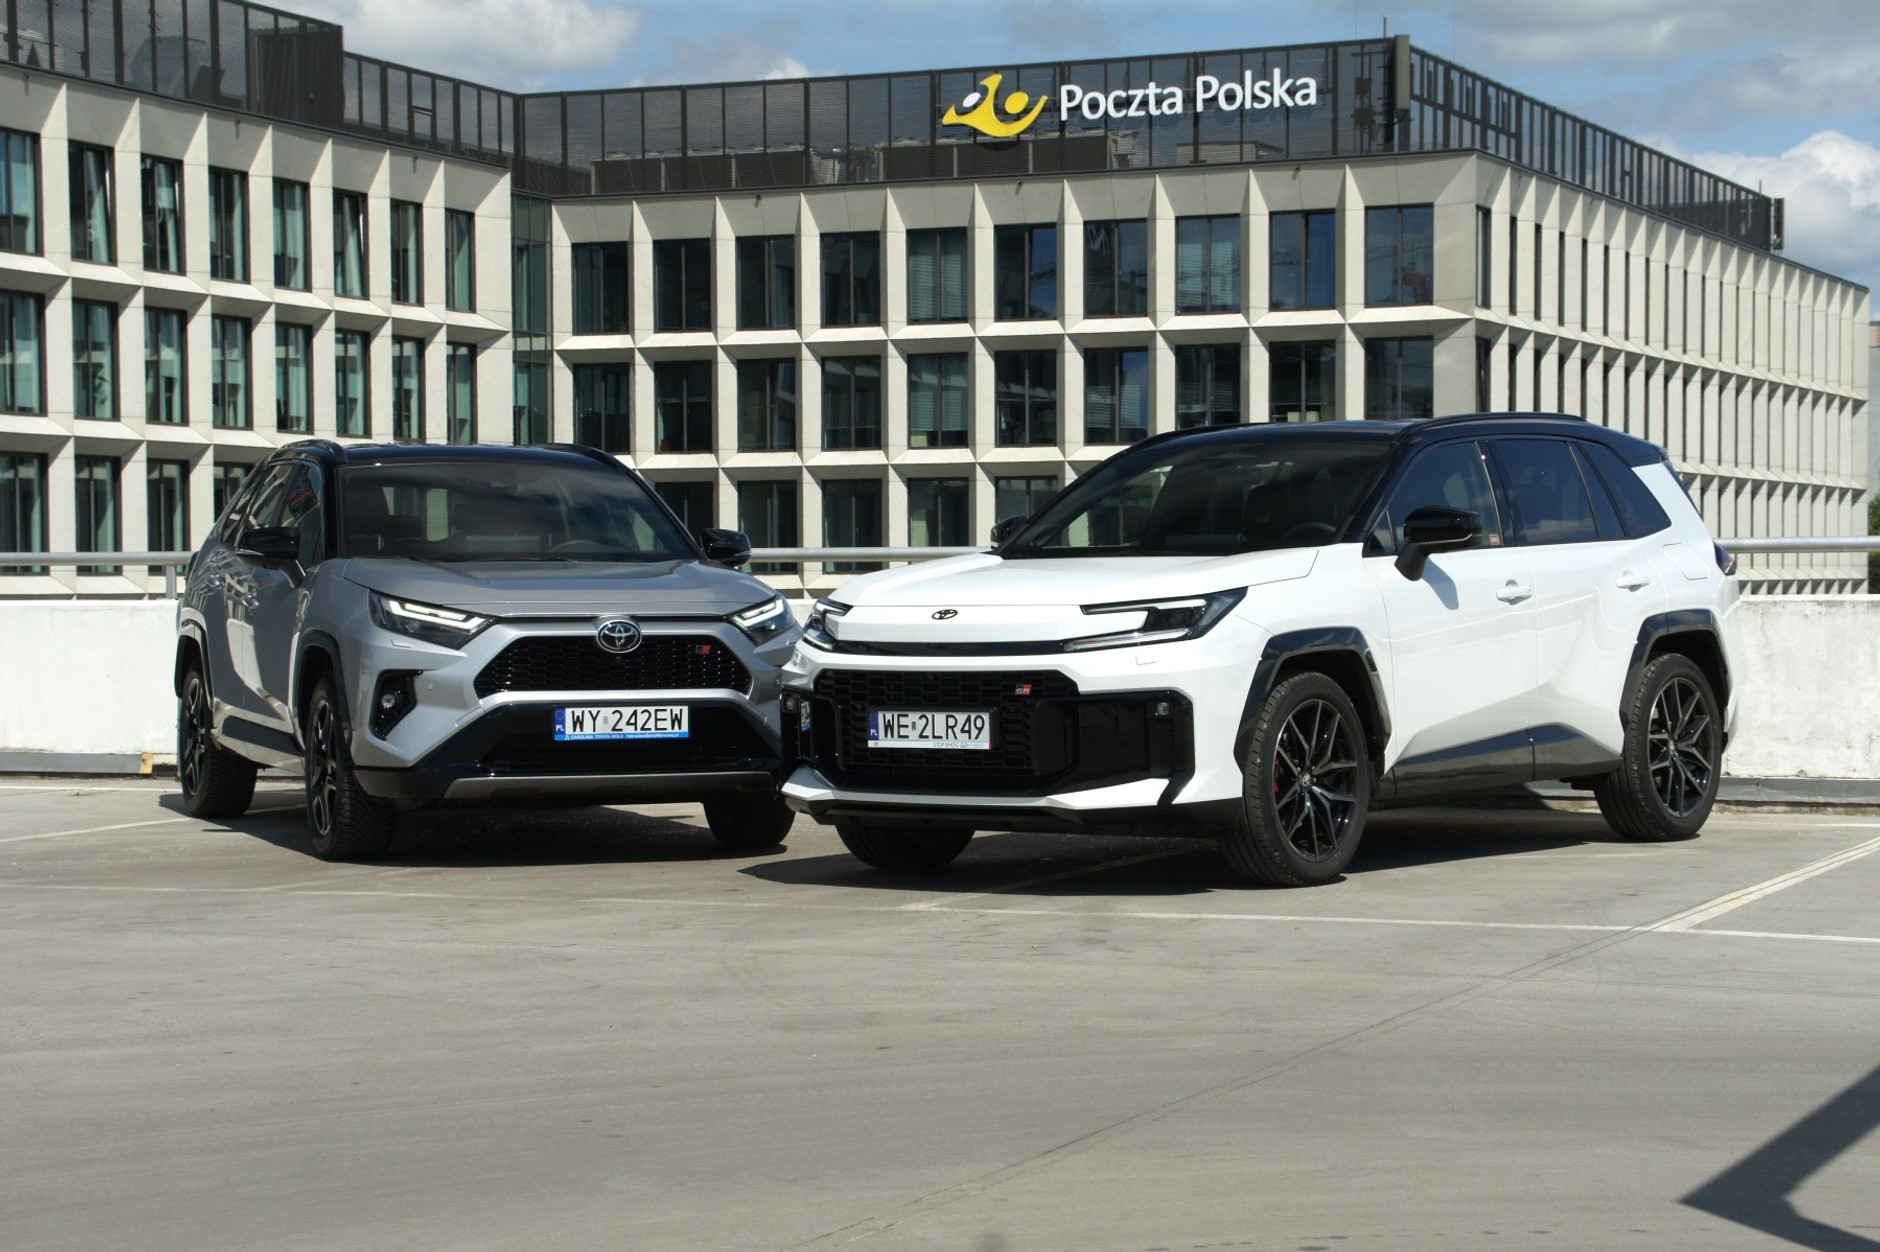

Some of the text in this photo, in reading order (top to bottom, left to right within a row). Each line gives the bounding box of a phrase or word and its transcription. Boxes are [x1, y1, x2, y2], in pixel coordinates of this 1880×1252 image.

[1060, 67, 1317, 121] Poczta Polska
[571, 708, 683, 732] WY 242EW
[883, 713, 985, 740] WE 2LR49
